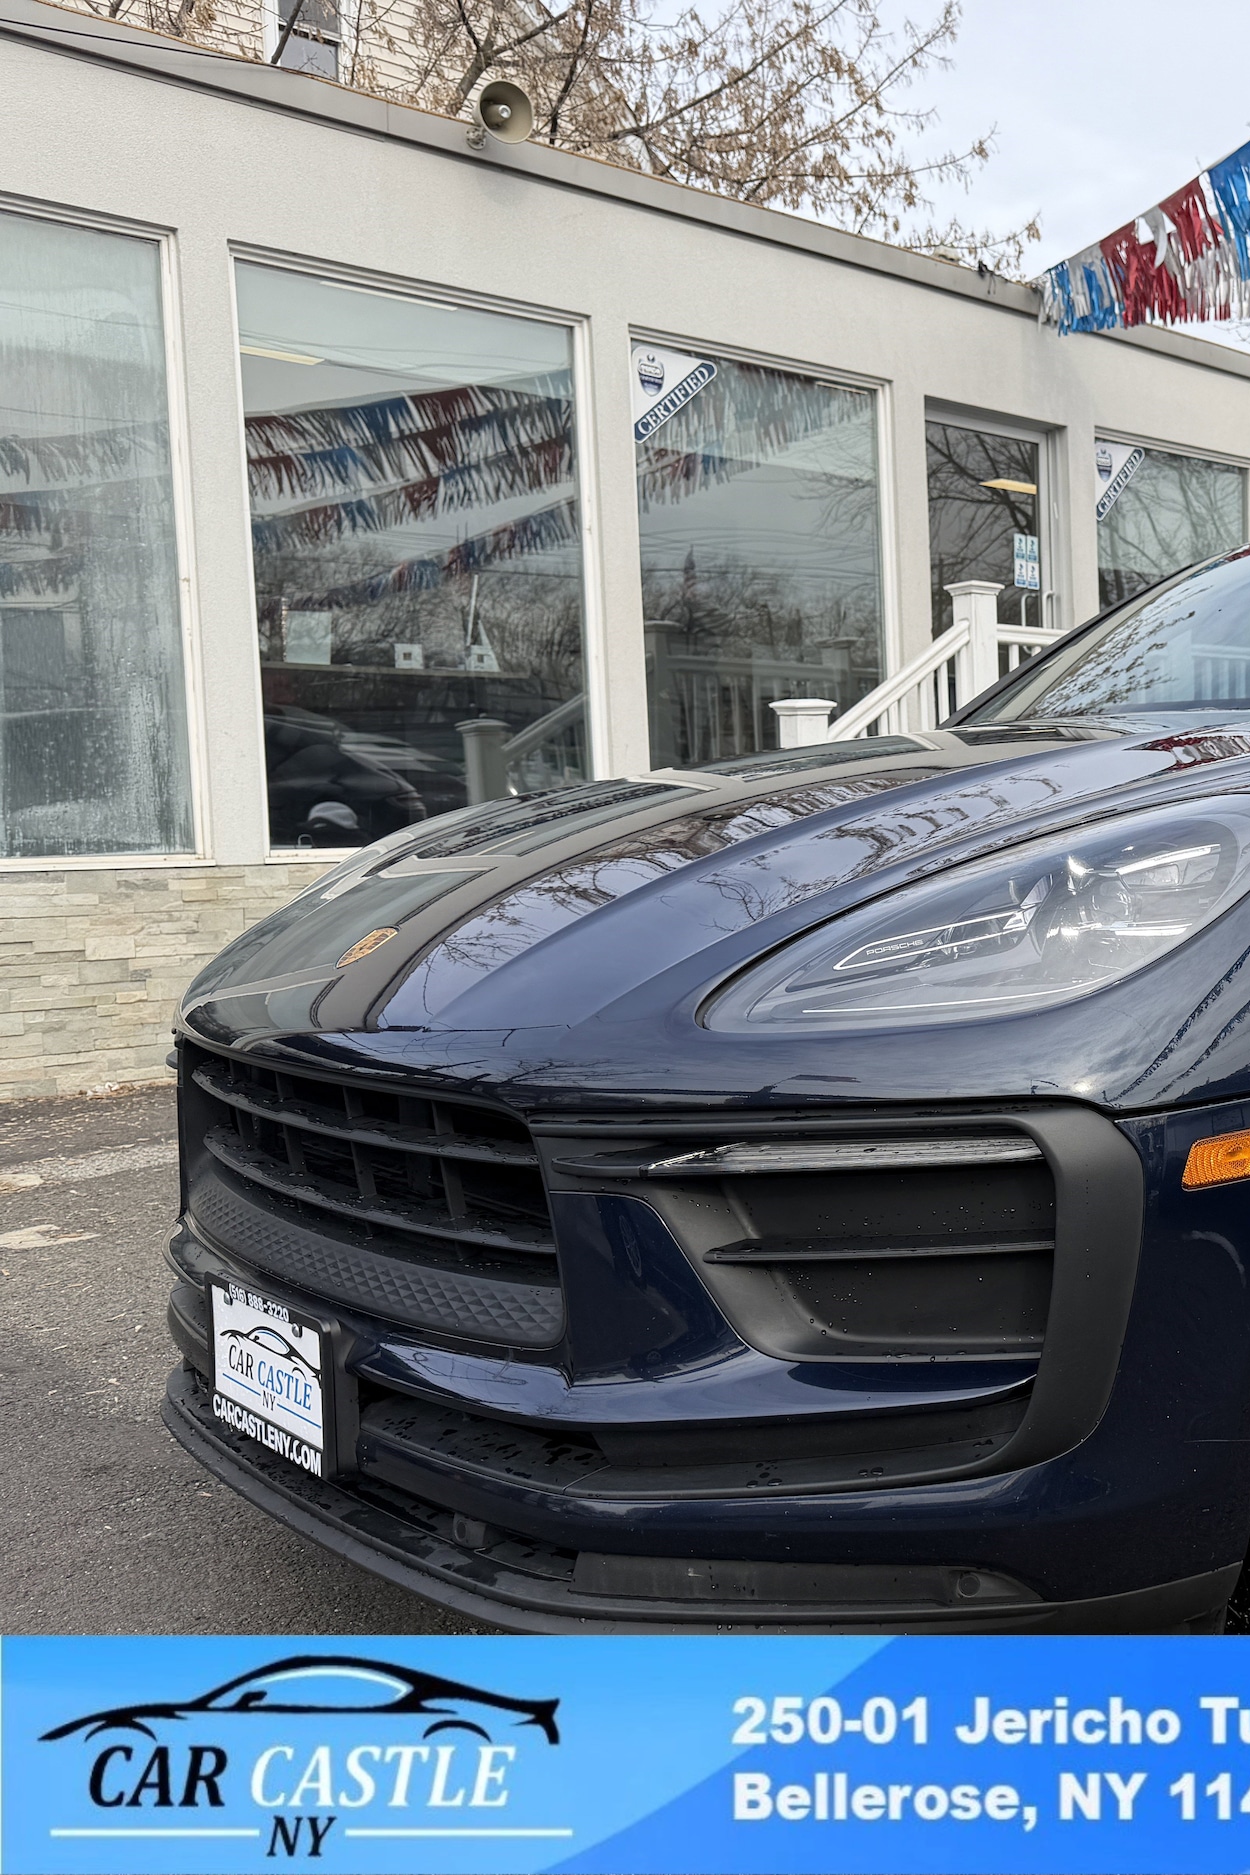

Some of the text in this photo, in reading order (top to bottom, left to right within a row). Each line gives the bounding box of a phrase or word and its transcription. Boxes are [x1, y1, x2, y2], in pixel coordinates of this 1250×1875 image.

[637, 366, 709, 435] CERTIFIED
[1098, 452, 1141, 514] CERTIFIED
[866, 939, 924, 955] PORSCHE
[228, 1283, 290, 1323] (516) 888-3220
[228, 1344, 313, 1411] CAR CASTLE
[262, 1389, 276, 1412] NY
[212, 1393, 322, 1478] CARCASTLENY.COM
